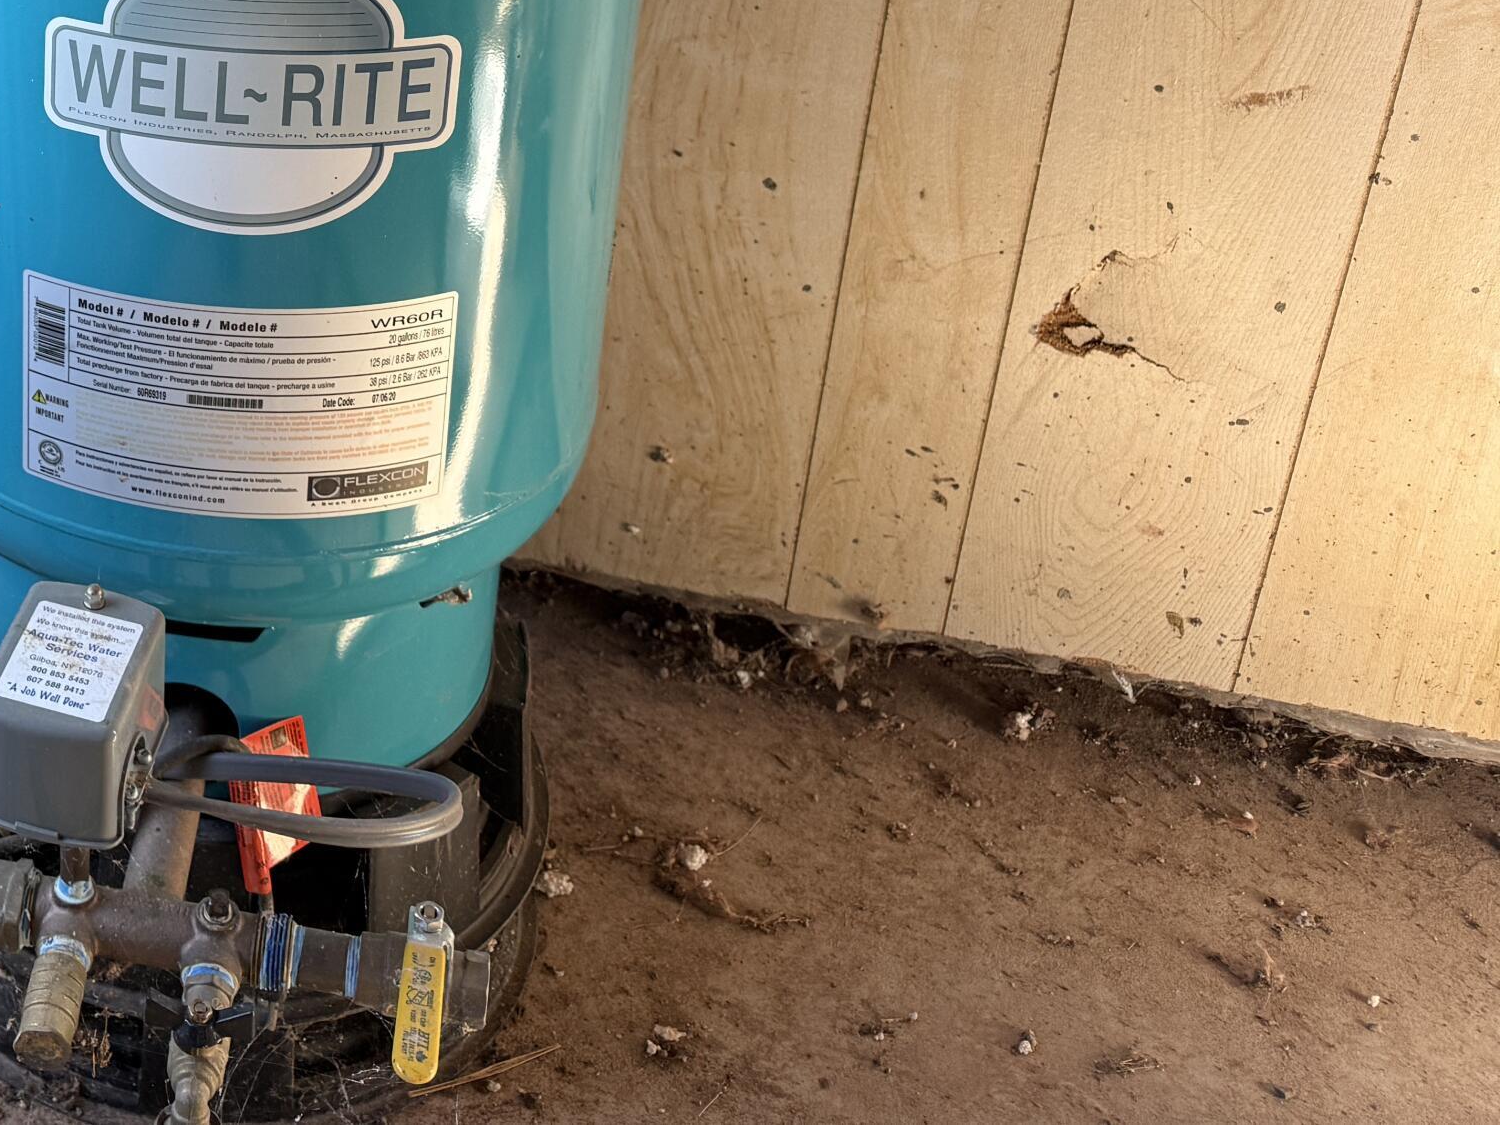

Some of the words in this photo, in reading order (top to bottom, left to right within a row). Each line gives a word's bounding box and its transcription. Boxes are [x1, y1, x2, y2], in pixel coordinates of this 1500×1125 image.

[316, 126, 431, 139] MASSACHUSETTS
[78, 298, 113, 315] Model
[116, 307, 124, 316] #
[143, 311, 189, 327] Modelo
[193, 319, 200, 328] #
[270, 323, 277, 332] #
[371, 309, 443, 328] WR60R
[77, 316, 91, 325] Total
[93, 320, 106, 329] Tank
[107, 323, 131, 334] Volume
[137, 329, 164, 340] Volumen
[167, 334, 180, 342] total
[183, 335, 193, 343] del
[195, 337, 217, 346] tanque
[389, 334, 396, 344] 20
[398, 332, 418, 344] gallons
[423, 329, 430, 337] 76
[77, 332, 91, 342] Max.
[92, 336, 132, 350] Working/Test
[134, 344, 162, 355] Pressure
[177, 350, 227, 362] funcionamiento
[272, 357, 295, 365] prueba
[370, 357, 380, 368] 125
[381, 357, 390, 367] psi
[395, 355, 405, 364] 8.6
[406, 353, 415, 362] Bar
[77, 357, 90, 366] Total
[92, 362, 123, 374] precharge
[124, 368, 139, 377] from
[141, 371, 164, 381] factory
[170, 376, 198, 386] Precarga
[211, 380, 233, 388] fabrica
[235, 381, 246, 389] del
[247, 382, 270, 390] tanque
[276, 382, 310, 391] precharge
[370, 377, 377, 387] 38
[378, 377, 388, 387] psi
[403, 372, 412, 382] Bar
[93, 379, 108, 389] Serial
[108, 383, 131, 394] Number:
[45, 393, 69, 408] WARNING
[322, 398, 336, 408] Date
[337, 397, 356, 407] Code:
[36, 406, 64, 423] IMPORTANT
[344, 466, 425, 488] FLEXCON
[131, 485, 225, 504] www.flexconind.com
[52, 621, 73, 632] know
[57, 610, 90, 622] installed
[107, 623, 135, 634] system
[29, 629, 84, 649] Aqua-Tec
[89, 643, 122, 657] Water
[46, 643, 98, 662] Services
[30, 654, 57, 668] Gilboa,
[31, 665, 47, 674] 800
[50, 670, 66, 679] 853
[68, 675, 89, 686] 5453
[21, 686, 36, 697] Job
[40, 690, 60, 703] Well
[26, 675, 44, 684] 607
[45, 680, 61, 689] 588
[64, 685, 85, 696] 9413
